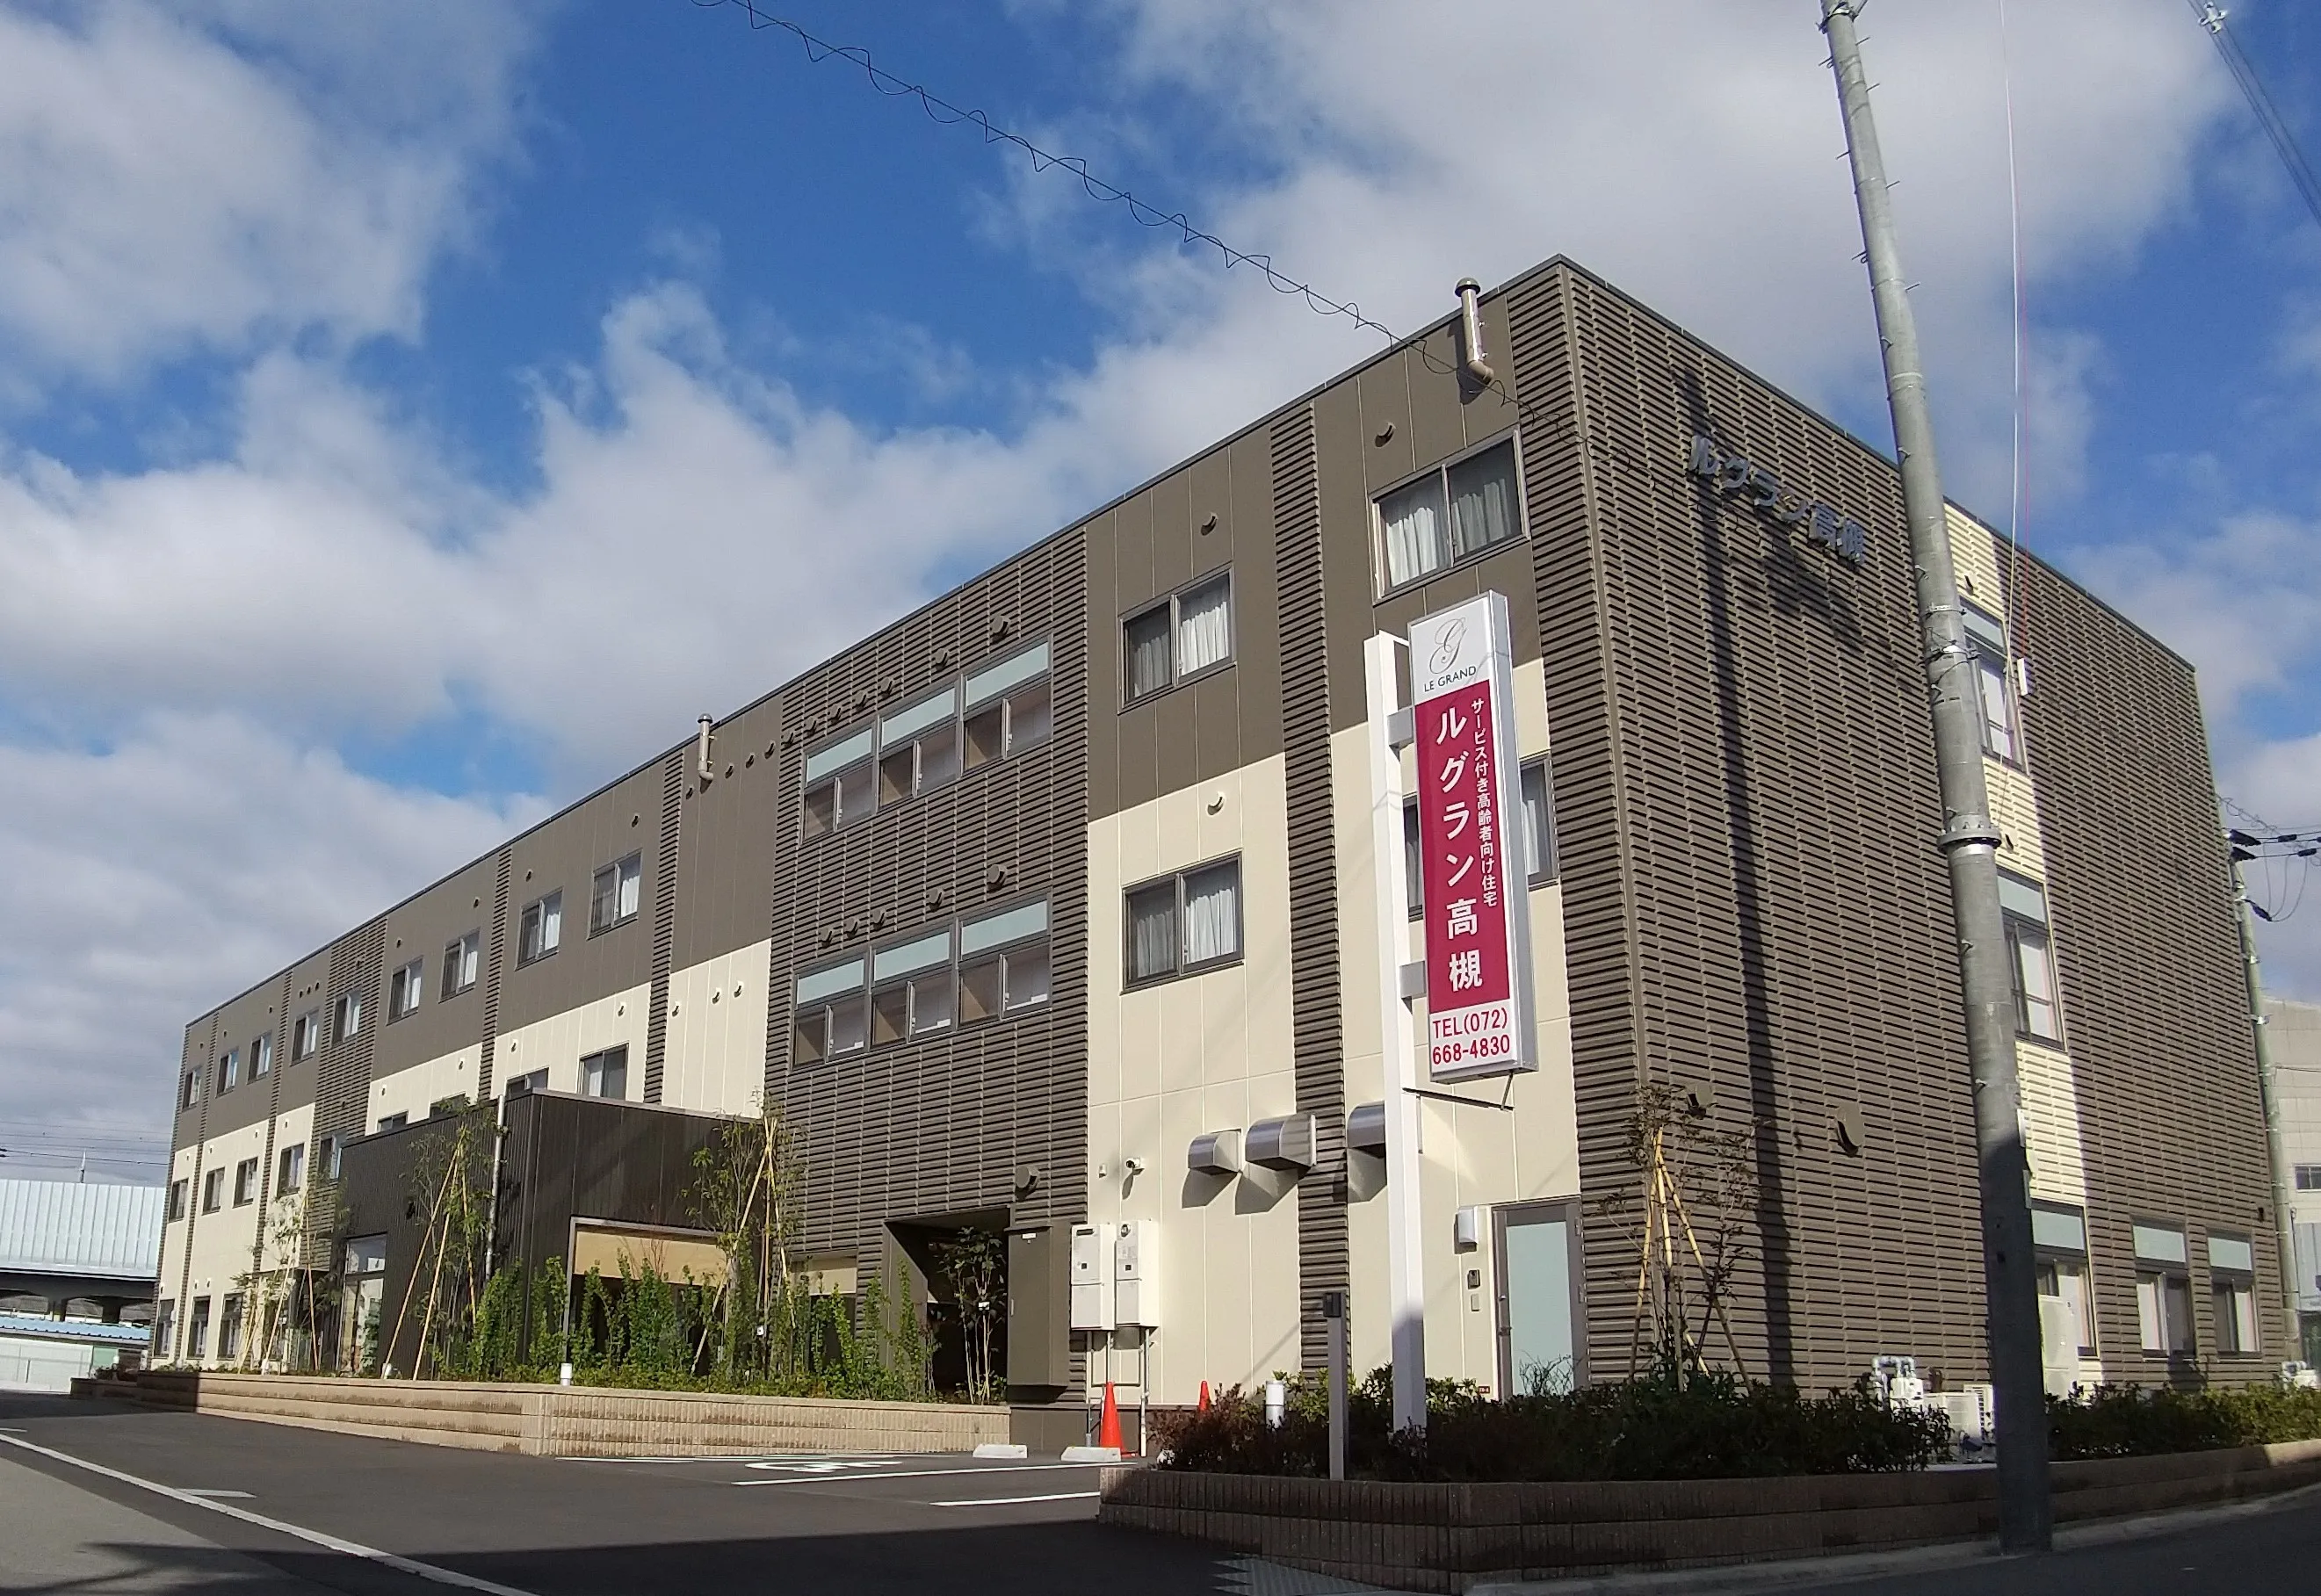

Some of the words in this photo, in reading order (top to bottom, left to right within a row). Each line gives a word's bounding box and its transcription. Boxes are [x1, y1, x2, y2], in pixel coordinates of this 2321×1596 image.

[1424, 676, 1435, 692] LE
[1437, 665, 1477, 687] GRAND
[1471, 697, 1498, 907] サービス付き高齢者向け住宅
[1435, 706, 1484, 992] ルグラン高槻
[1432, 1007, 1508, 1039] TEL(072)
[1432, 1033, 1511, 1065] 668-4830
